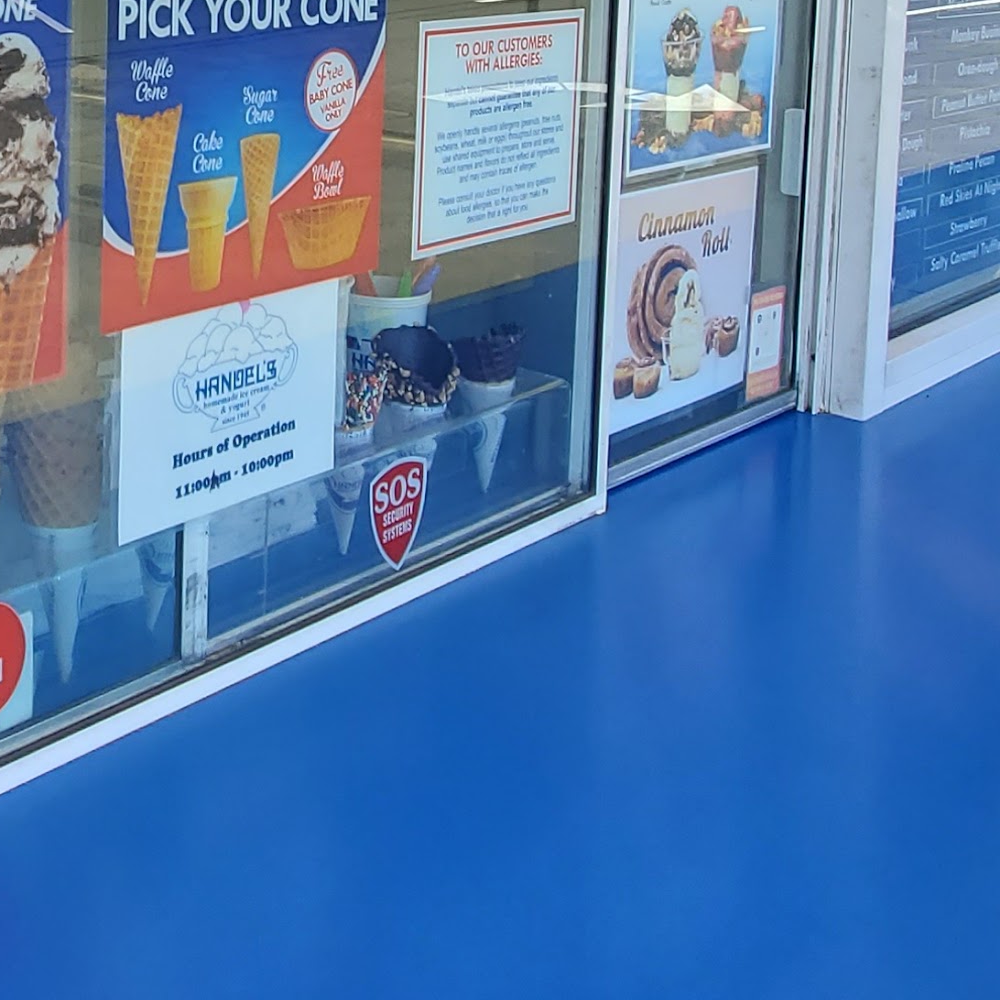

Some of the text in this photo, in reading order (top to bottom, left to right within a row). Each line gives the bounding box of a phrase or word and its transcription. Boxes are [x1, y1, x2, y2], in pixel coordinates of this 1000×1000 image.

[455, 34, 553, 58] TO OUR CUSTOMERS
[131, 56, 174, 83] Waffle
[316, 60, 344, 87] Free
[465, 52, 543, 74] WITH ALLERGIES:
[135, 82, 168, 102] Cone
[243, 86, 278, 107] Sugar
[309, 78, 353, 105] BABY CONE
[245, 105, 275, 125] Cone
[320, 98, 346, 114] VANILLA
[325, 109, 343, 122] ONLY
[193, 132, 224, 153] Cake
[193, 152, 223, 173] Cone
[312, 161, 344, 183] Waffle
[313, 178, 343, 200] Bowl
[637, 205, 716, 242] Cinnamon
[701, 227, 731, 258] Roll
[195, 359, 278, 401] HANDEL'S
[172, 419, 297, 470] Hours of Operation
[241, 449, 294, 476] 10:00pm
[374, 467, 421, 514] SOS
[382, 501, 414, 528] SECURITY
[382, 518, 413, 545] SYSTEMS
